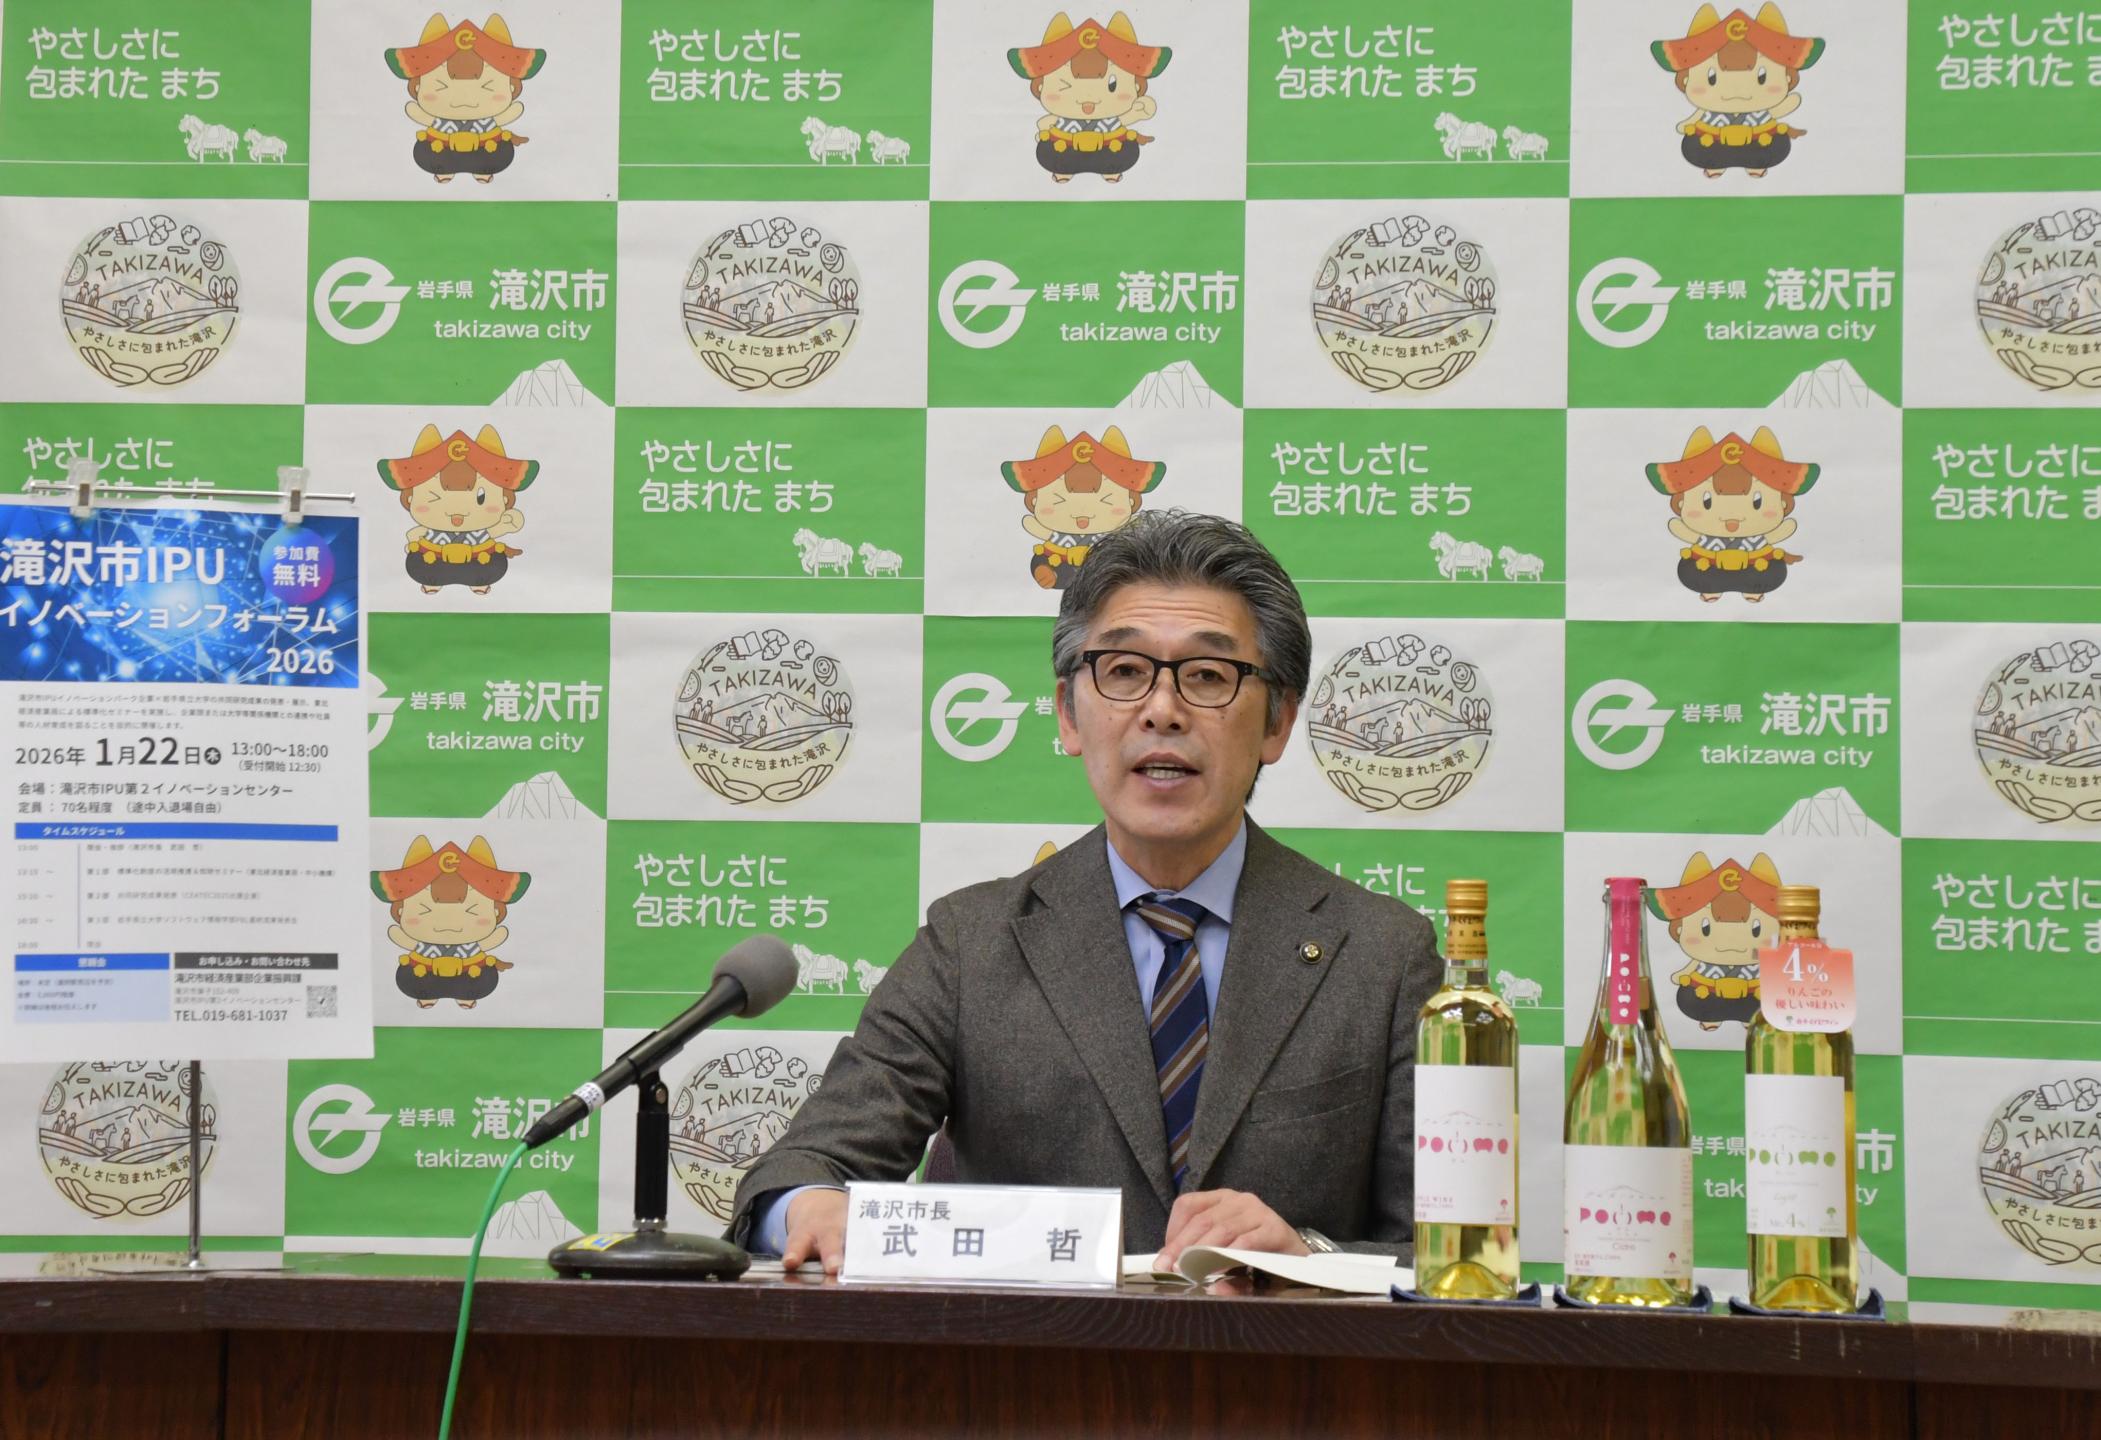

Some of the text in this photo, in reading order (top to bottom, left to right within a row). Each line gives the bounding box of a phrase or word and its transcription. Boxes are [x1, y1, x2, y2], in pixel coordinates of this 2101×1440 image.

[30, 26, 179, 62] やさしさに
[649, 29, 802, 64] やさしさに
[1279, 24, 1434, 60] やさしさに
[1939, 11, 2101, 49] やさしさに
[26, 66, 221, 101] 包まれた まち
[648, 67, 843, 103] 包まれた まち
[1274, 63, 1478, 101] 包まれた まち
[1935, 53, 2072, 91] 包まれた
[96, 253, 205, 285] TAKIZAWA
[715, 256, 825, 288] TAKIZAWA
[1347, 254, 1460, 287] TAKIZAWA
[417, 266, 609, 313] 岩手県 滝沢市
[1042, 269, 1241, 315] 岩手県 滝沢市
[1686, 265, 1896, 311] 岩手県 滝沢市
[82, 324, 218, 355] やさしさに包まれた滝沢
[433, 318, 590, 340] takizawa city
[703, 327, 838, 359] やさしさに包まれた滝沢
[1059, 323, 1221, 345] takizawa city
[1334, 327, 1474, 360] やさしさに包まれた滝沢
[1704, 320, 1874, 341] takizawa city
[23, 436, 175, 471] やさしさに
[639, 439, 792, 475] やさしさに
[1272, 441, 1427, 476] やさしさに
[1933, 442, 2101, 479] やさしさに
[639, 478, 834, 514] 包まれた まち
[1268, 481, 1472, 518] 包まれた まち
[1930, 483, 2068, 522] 包まれた
[1, 538, 226, 587] 滝沢市IPU
[272, 545, 320, 563] 参加費
[272, 564, 321, 588] 無料
[0, 600, 338, 635] イノベーションフォーラム
[266, 647, 335, 675] 2026
[707, 666, 818, 699] TAKIZAWA
[1341, 675, 1456, 707] TAKIZAWA
[410, 679, 604, 722] 岩手県 滝沢市
[1682, 690, 1893, 738] 岩手県 滝沢市
[15, 745, 87, 768] 2026年
[426, 731, 584, 754] takizawa city
[696, 741, 832, 772] やさしさに包まれた滝沢
[1699, 745, 1874, 769] takizawa city
[1329, 747, 1471, 780] やさしさに包まれた滝沢
[42, 826, 126, 837] タイムスケジュール
[633, 852, 789, 889] やさしさに
[1933, 873, 2101, 912] やさしさに
[633, 891, 829, 930] 包まれた まち
[1931, 914, 2070, 954] 包まれた
[198, 956, 311, 968] お申し込み・お問い合わせ先
[1783, 946, 1829, 983] 4%
[1787, 986, 1833, 998] りんごの
[174, 1009, 288, 1022] TEL.019-681-1037
[73, 1081, 182, 1113] TAKIZAWA
[701, 1087, 800, 1115] TAKIZAW
[398, 1107, 456, 1127] 岩手県
[59, 1155, 191, 1185] やさしさに包まれた滝沢
[527, 1150, 573, 1172] city
[858, 1199, 952, 1222] 滝沢市長
